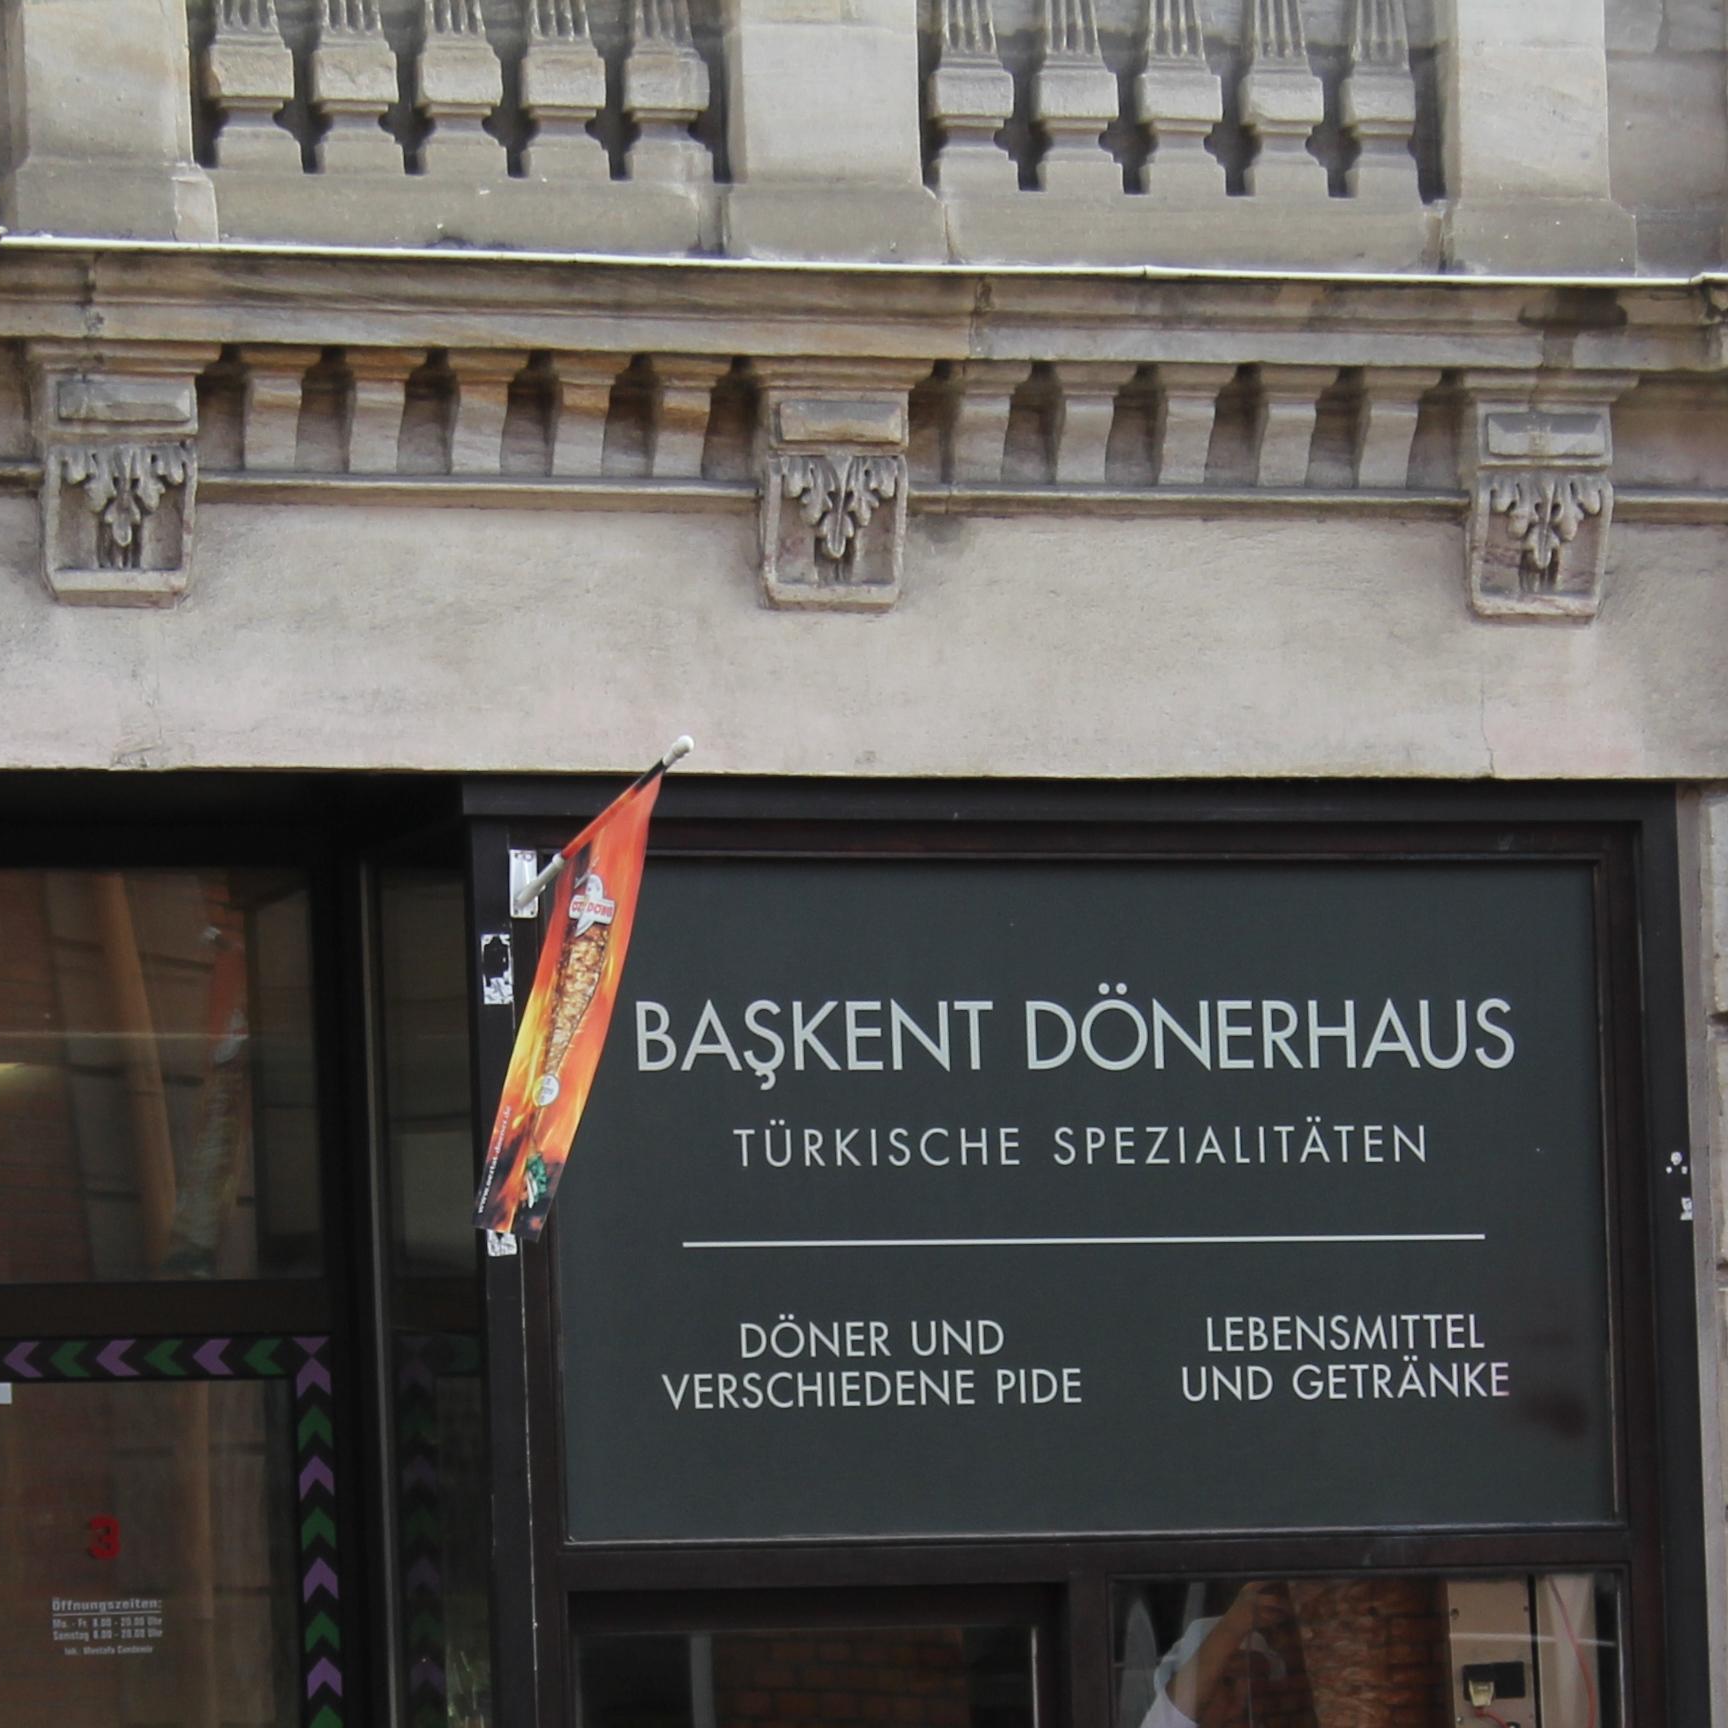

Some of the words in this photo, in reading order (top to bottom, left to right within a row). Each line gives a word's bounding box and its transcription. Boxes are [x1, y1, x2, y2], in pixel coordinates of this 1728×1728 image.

[634, 998, 994, 1091] BAŞKENT
[1024, 982, 1516, 1072] DÖNERHAUS
[732, 1118, 1021, 1168] TÜRKISCHE
[1052, 1115, 1428, 1166] SPEZIALITÄTEN
[739, 1313, 892, 1360] DÖNER
[910, 1318, 1006, 1358] UND
[1205, 1313, 1486, 1353] LEBENSMITTEL
[660, 1369, 976, 1411] VERSCHIEDENE
[995, 1367, 1083, 1405] PIDE
[1181, 1364, 1274, 1402] UND
[1291, 1354, 1511, 1401] GETRÄNKE
[89, 1513, 122, 1560] 3
[51, 1596, 162, 1612] Öffnungszeiten:
[52, 1630, 90, 1642] Samstag
